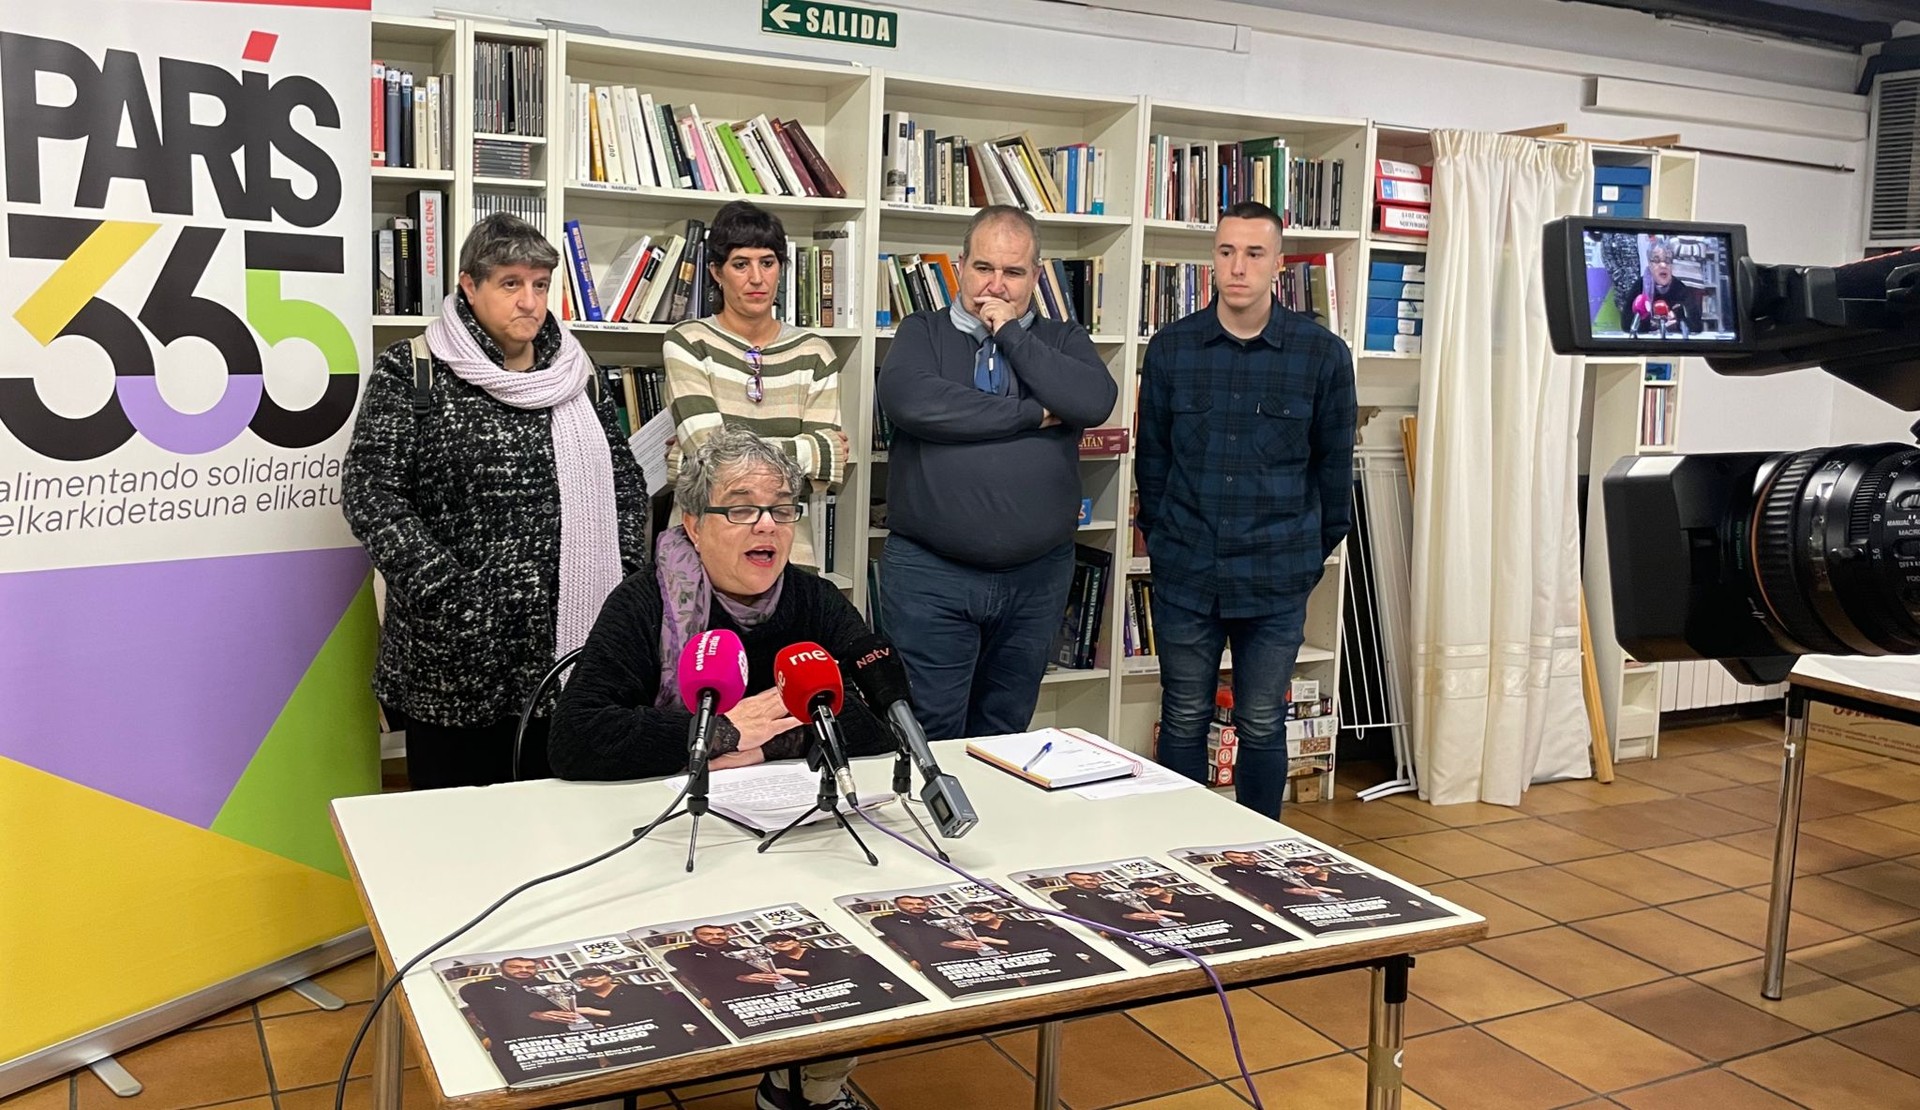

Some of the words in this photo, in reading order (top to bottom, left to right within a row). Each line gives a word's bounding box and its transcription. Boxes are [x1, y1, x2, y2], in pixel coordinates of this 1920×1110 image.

[806, 7, 890, 41] SALIDA
[0, 30, 342, 228] PARÍS
[425, 197, 434, 222] CINE
[426, 226, 434, 244] DEL
[426, 246, 436, 277] ATLAS
[0, 213, 360, 461] 365
[1080, 436, 1104, 448] ATAN
[0, 461, 199, 502] alimentando
[206, 453, 343, 488] solidarida
[0, 494, 248, 537] elkarkidetasuna
[256, 483, 343, 513] elikatu
[1873, 513, 1881, 522] 10
[788, 649, 828, 666] rne
[508, 1037, 562, 1051] ARIMA
[590, 1030, 649, 1046] ALDEKO
